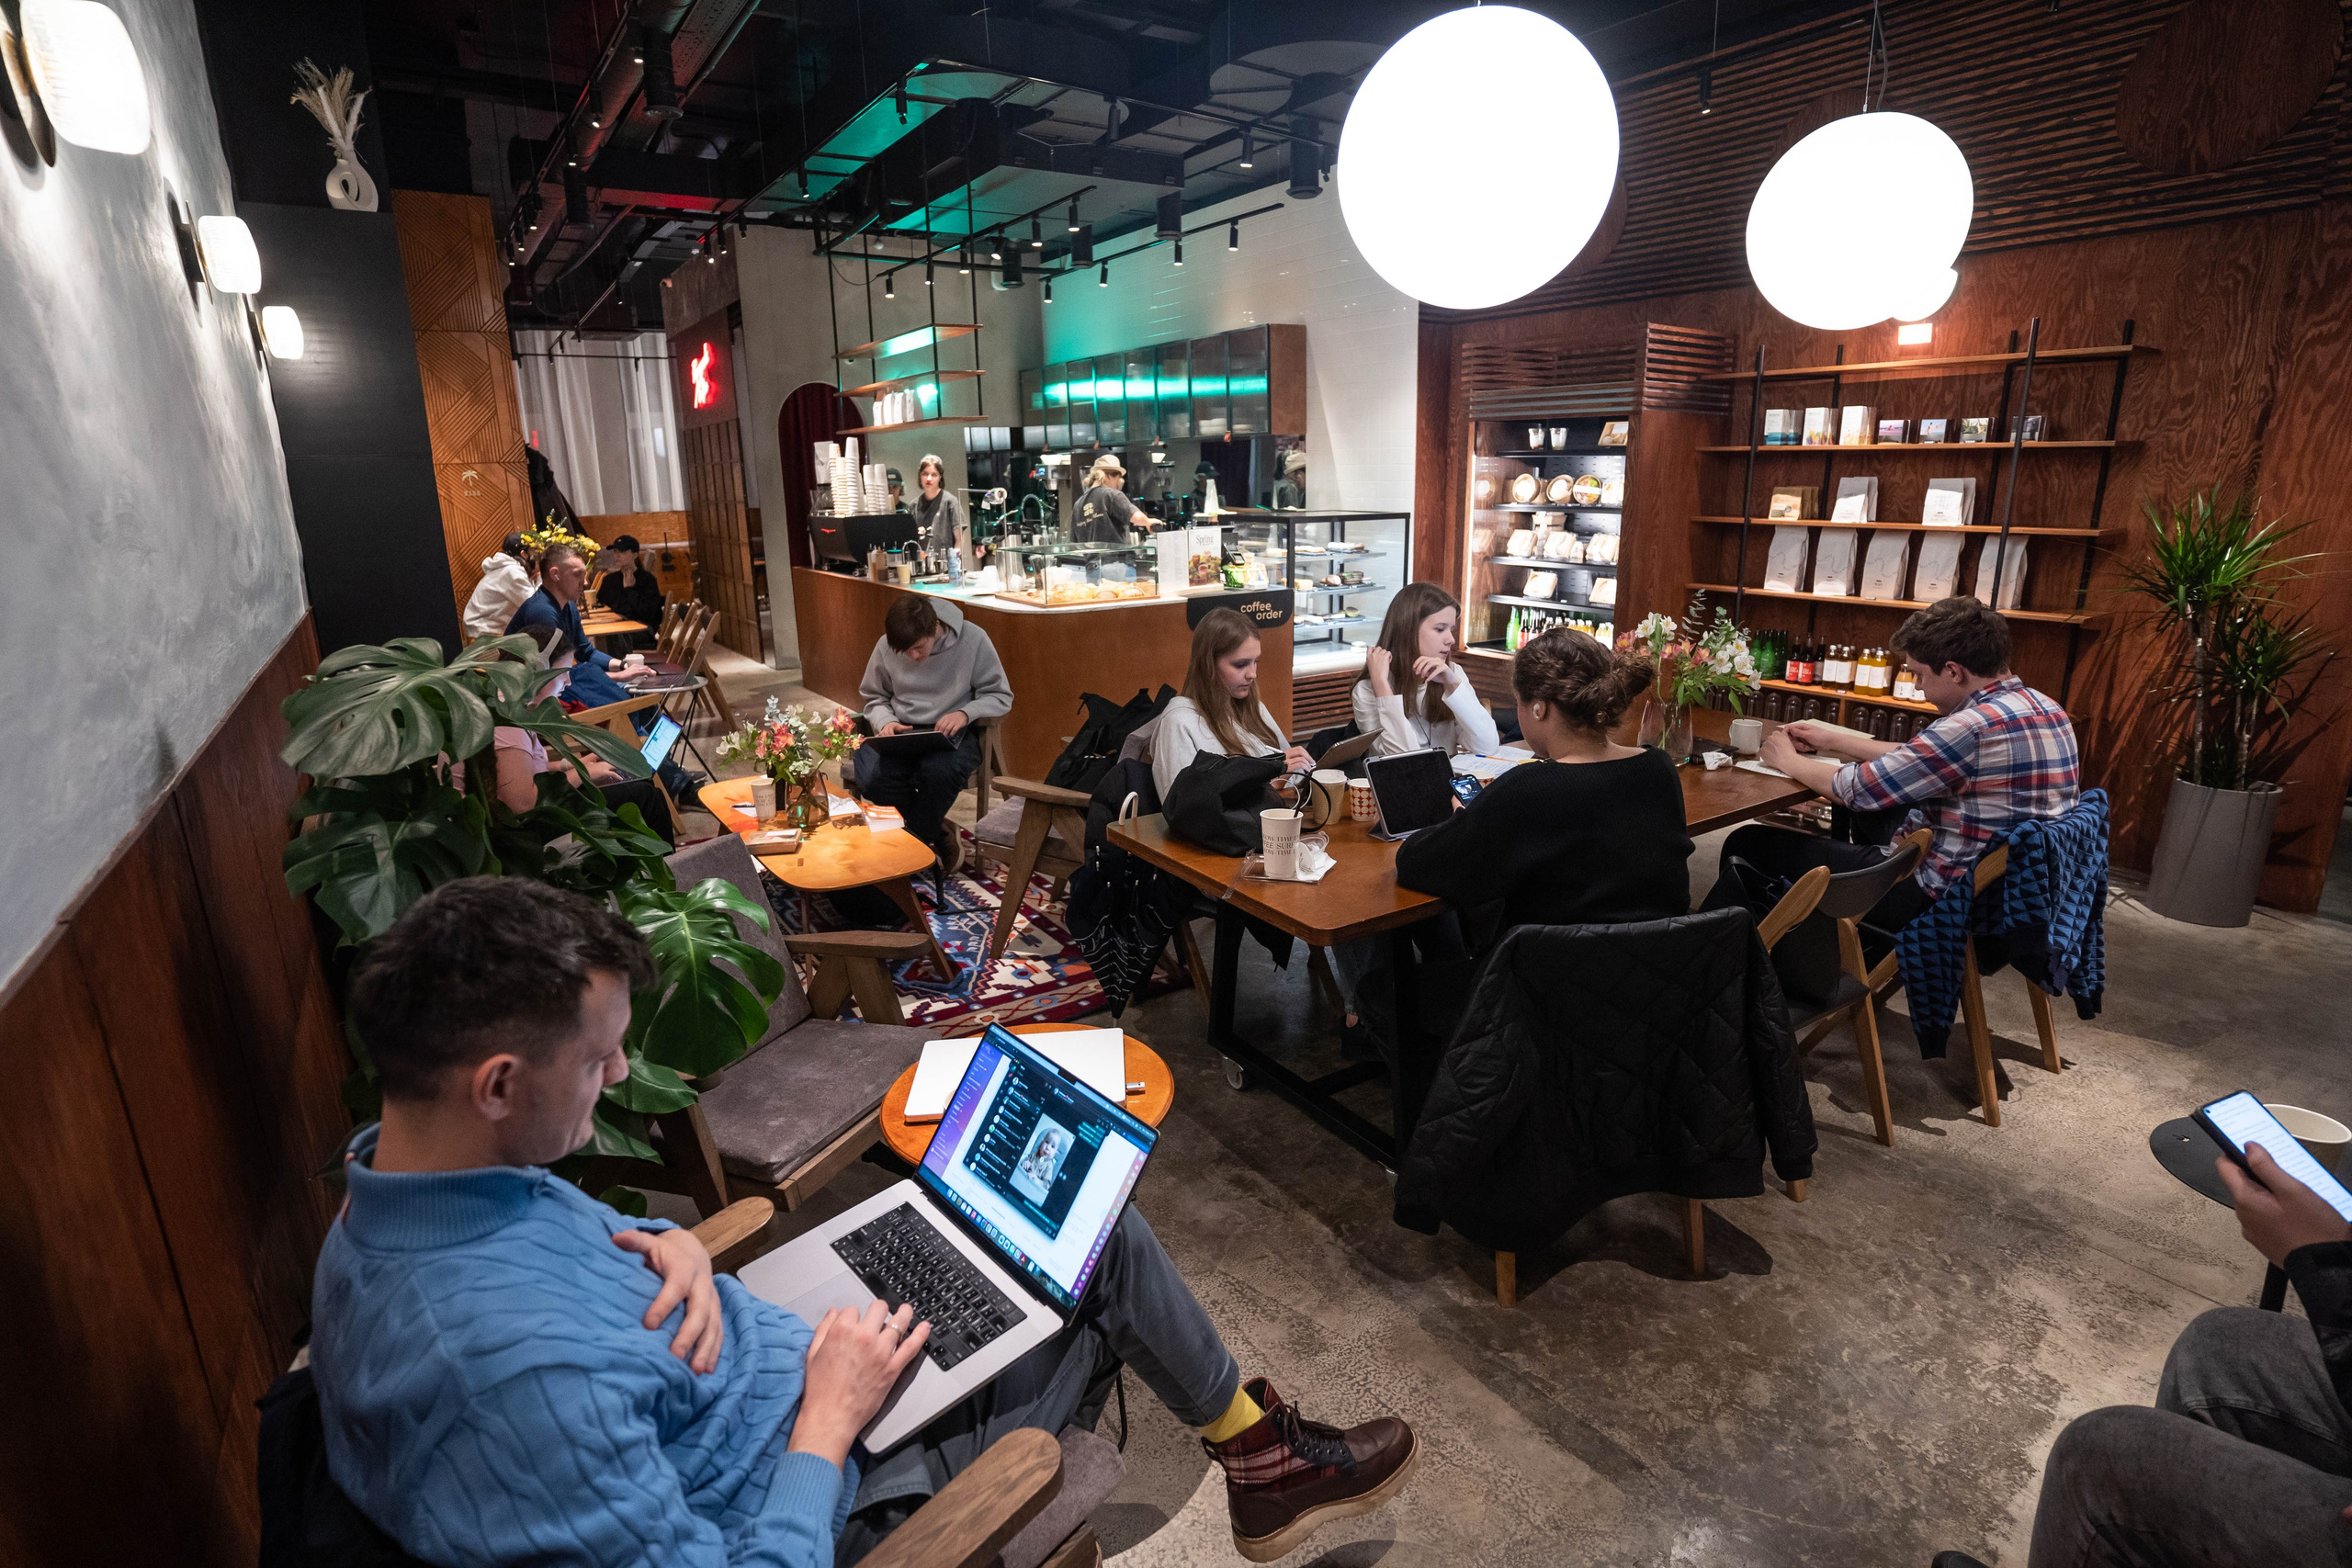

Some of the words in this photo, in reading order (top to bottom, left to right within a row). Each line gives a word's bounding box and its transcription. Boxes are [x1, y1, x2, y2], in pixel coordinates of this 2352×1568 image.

[1196, 535, 1214, 546] Spring
[1240, 601, 1272, 613] coffee
[1256, 610, 1283, 620] order
